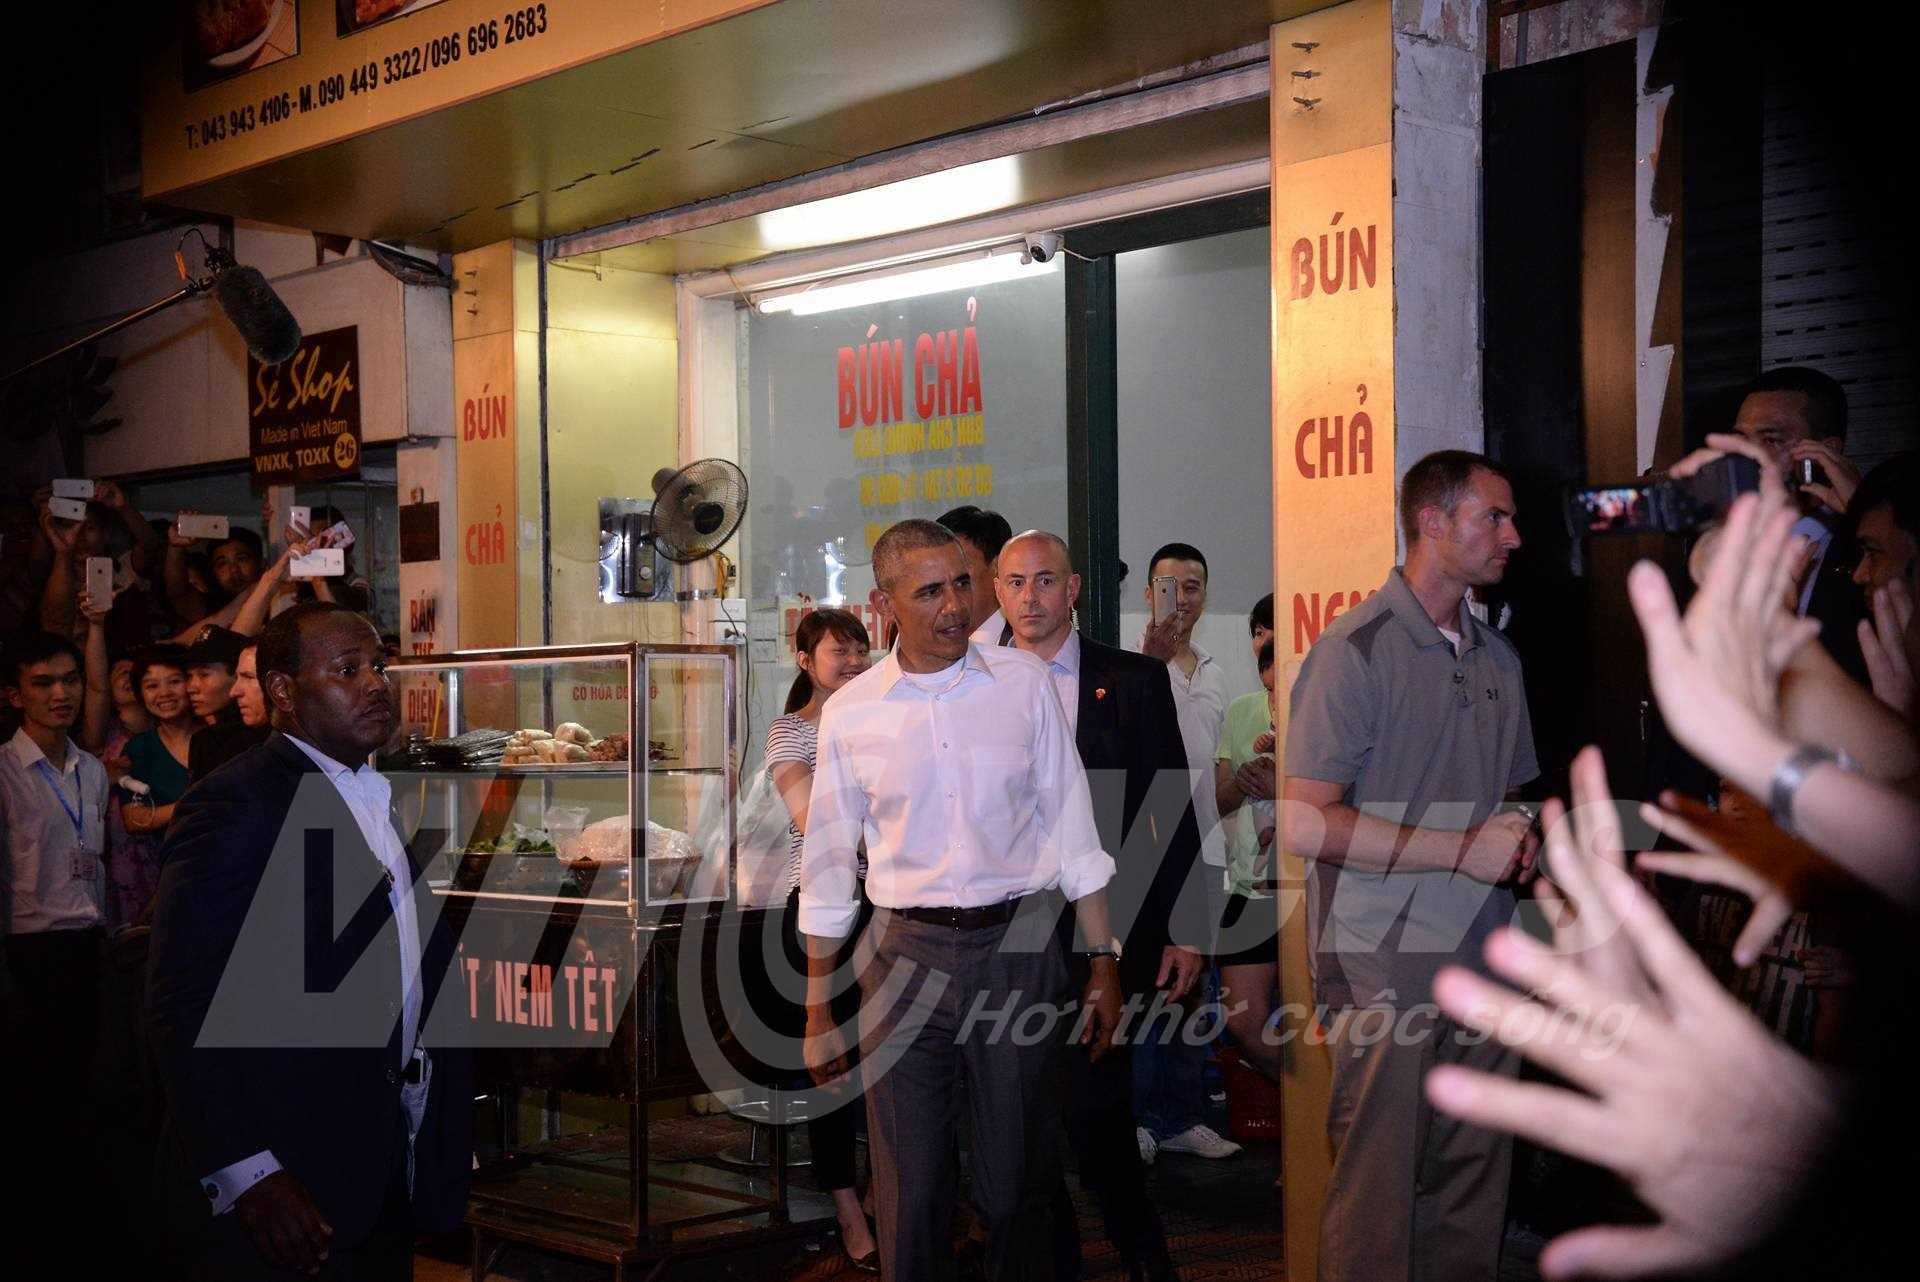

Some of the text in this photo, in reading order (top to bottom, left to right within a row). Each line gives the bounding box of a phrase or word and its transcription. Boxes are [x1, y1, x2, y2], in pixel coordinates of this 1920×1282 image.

[201, 115, 226, 146] 043
[230, 105, 255, 136] 943
[349, 62, 378, 95] 449
[467, 20, 498, 56] 696
[504, 3, 548, 44] 2683
[1290, 212, 1377, 300] BÚN
[287, 345, 354, 413] Shop
[836, 296, 984, 429] BÚN CHẢ
[323, 418, 348, 436] Nam
[463, 384, 507, 442] BÚN
[1294, 383, 1374, 480] CHẢ
[296, 446, 331, 467] TQXK
[465, 505, 505, 566] CHẢ
[496, 961, 553, 1028] NEM
